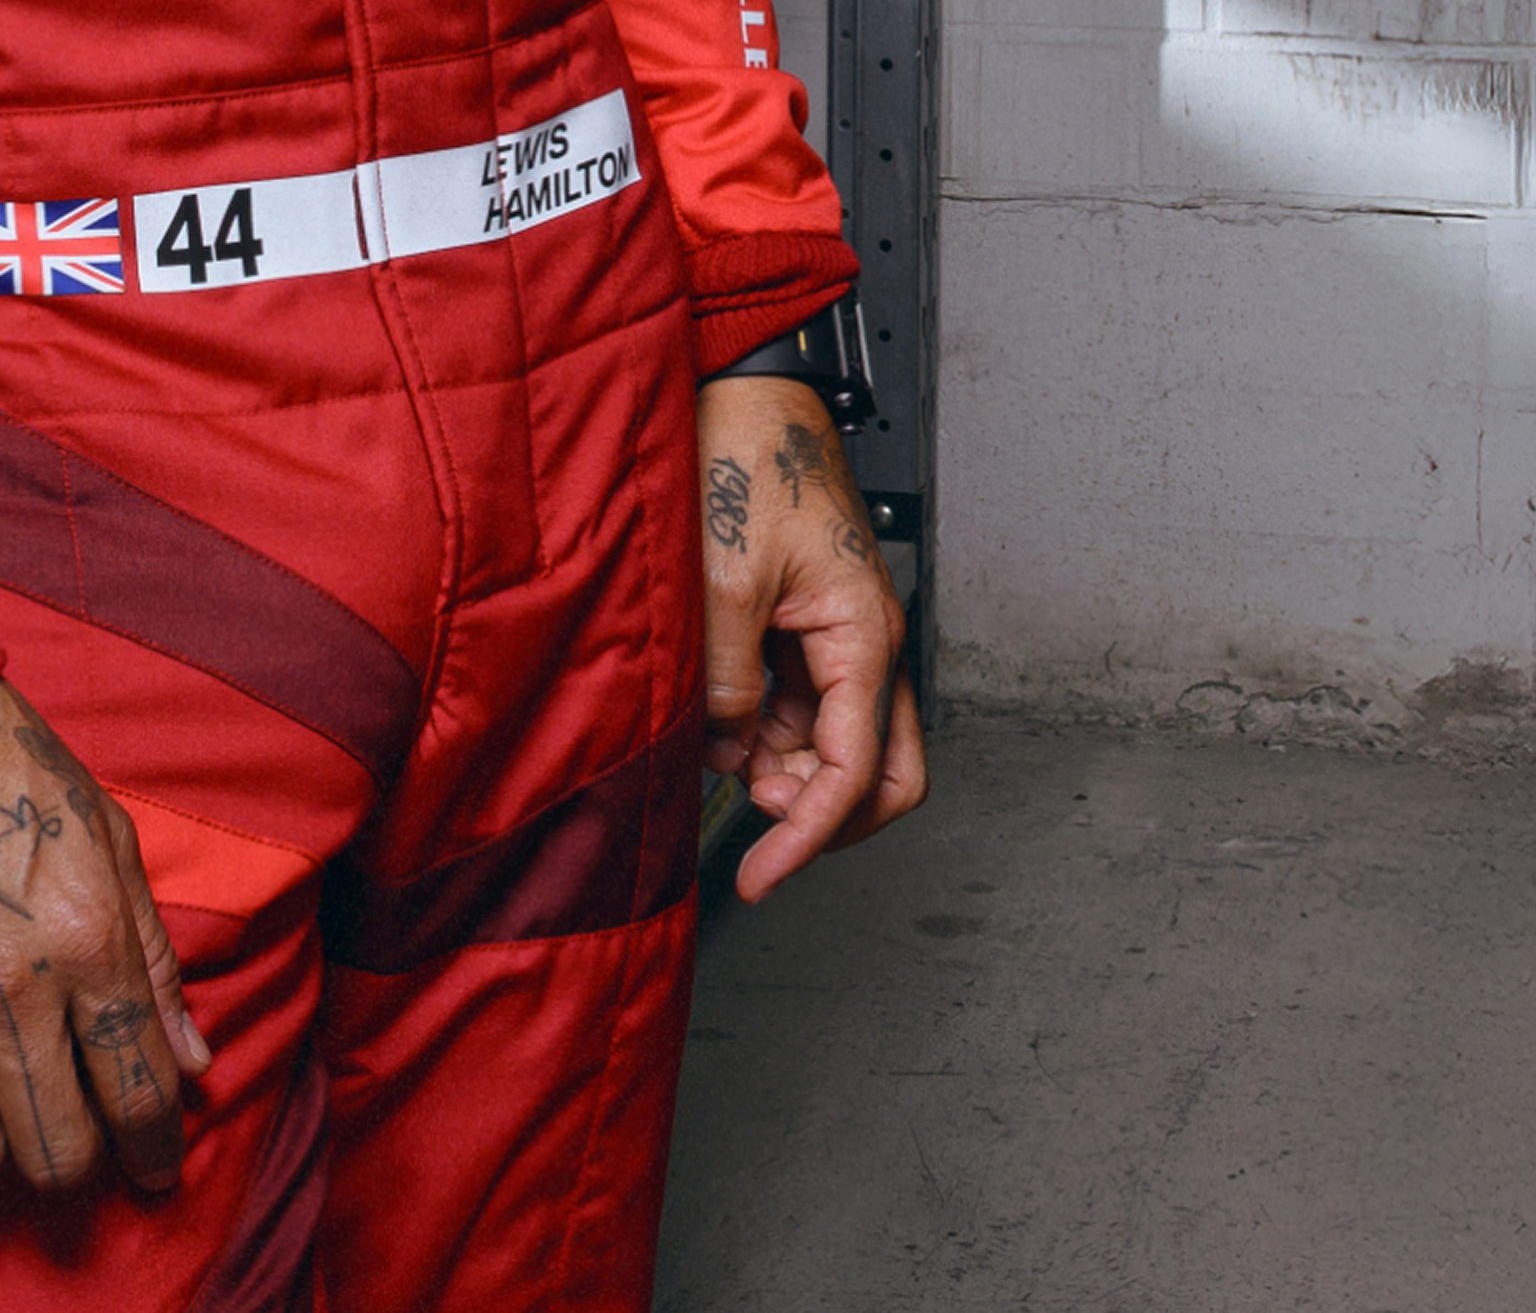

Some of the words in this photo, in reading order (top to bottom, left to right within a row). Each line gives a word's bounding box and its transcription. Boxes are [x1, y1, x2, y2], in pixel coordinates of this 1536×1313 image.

[480, 122, 570, 188] LEWIS
[483, 141, 632, 234] HAMILTON
[155, 186, 264, 286] 44
[707, 456, 751, 554] 1985
